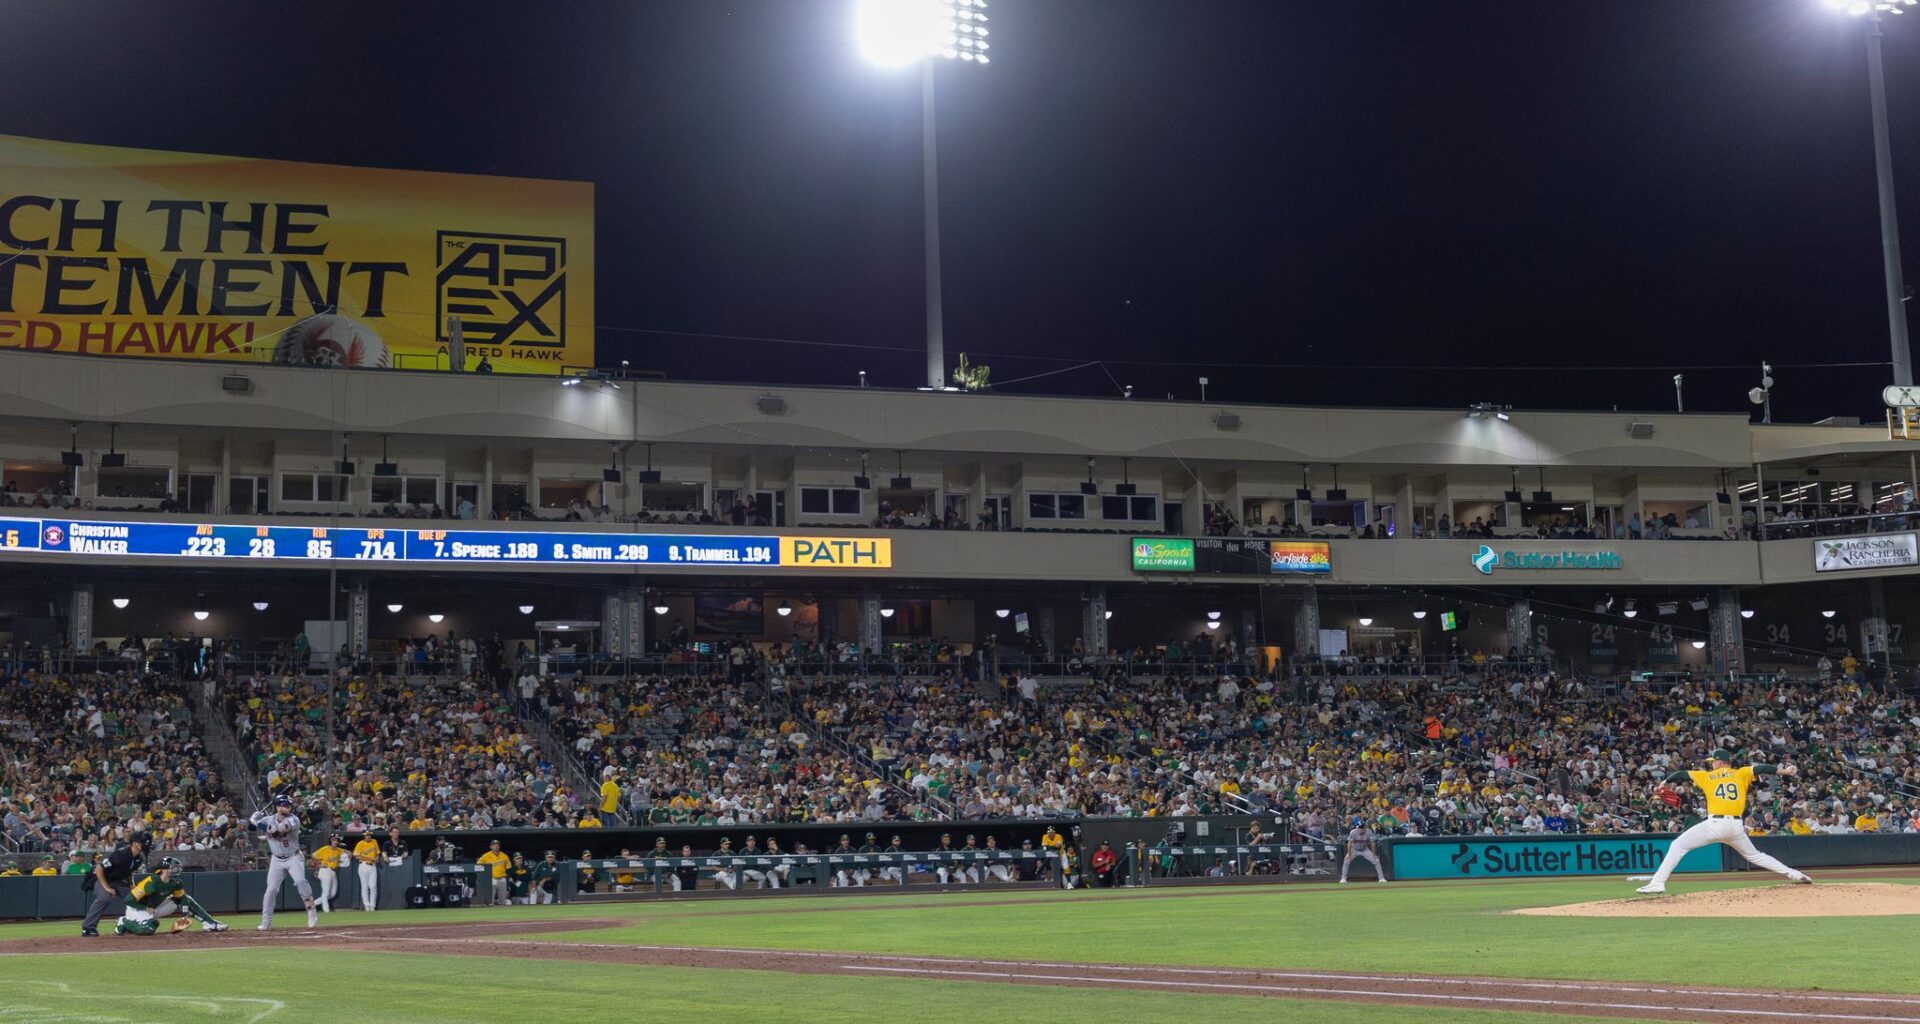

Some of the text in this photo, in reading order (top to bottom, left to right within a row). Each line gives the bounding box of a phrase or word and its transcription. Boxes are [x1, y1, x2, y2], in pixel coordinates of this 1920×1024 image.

[0, 196, 330, 255] CH THE
[445, 241, 465, 249] THE
[76, 321, 255, 354] HAWK!
[465, 347, 503, 357] RED
[511, 349, 563, 361] HAWK
[256, 526, 269, 537] HR
[312, 528, 328, 539] RBI
[367, 529, 385, 540] OPS
[418, 530, 448, 541] DUE UP
[181, 537, 226, 556] .223
[249, 538, 275, 557] 28
[307, 540, 332, 559] 85
[355, 541, 396, 559] .714
[434, 542, 449, 557] 7.
[553, 544, 569, 559] 8.
[1152, 545, 1191, 558] Sports
[1196, 540, 1223, 549] VISITOR
[1244, 541, 1266, 550] HOME
[669, 546, 683, 561] 9.
[742, 546, 771, 562] .194
[1271, 552, 1309, 565] Surfside
[1503, 550, 1622, 569] Sutter Health
[1591, 625, 1615, 643] 24
[1650, 625, 1673, 643] 43
[1766, 624, 1790, 643] 34
[1824, 624, 1847, 643] 34
[1714, 783, 1738, 801] 49
[1484, 843, 1665, 872] Sutter Health
